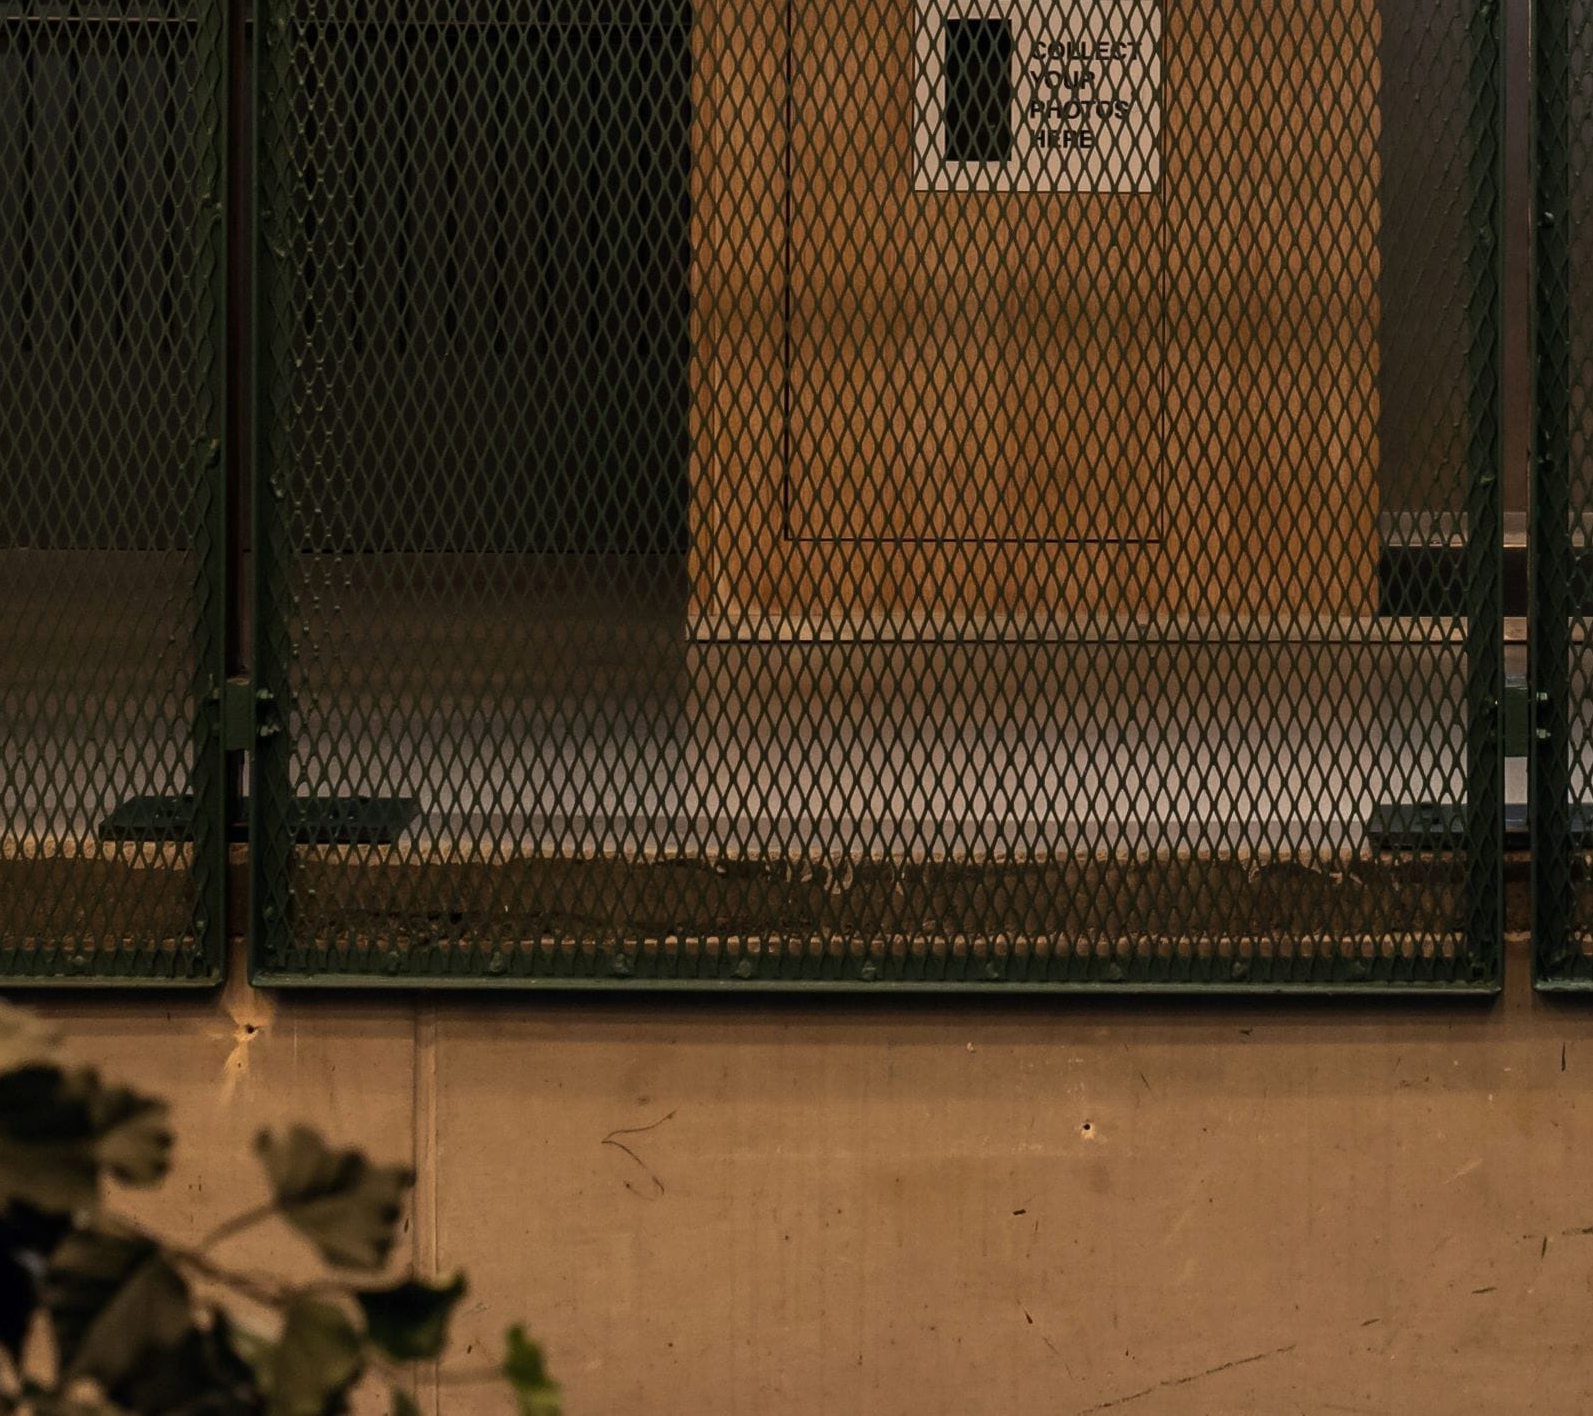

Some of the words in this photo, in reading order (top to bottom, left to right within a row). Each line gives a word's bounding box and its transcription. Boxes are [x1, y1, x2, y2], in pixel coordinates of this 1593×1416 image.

[1031, 41, 1142, 61] COLLECT
[1030, 71, 1096, 90] YOUR
[1030, 100, 1131, 120] PHOTOS
[1031, 129, 1095, 149] HERE
